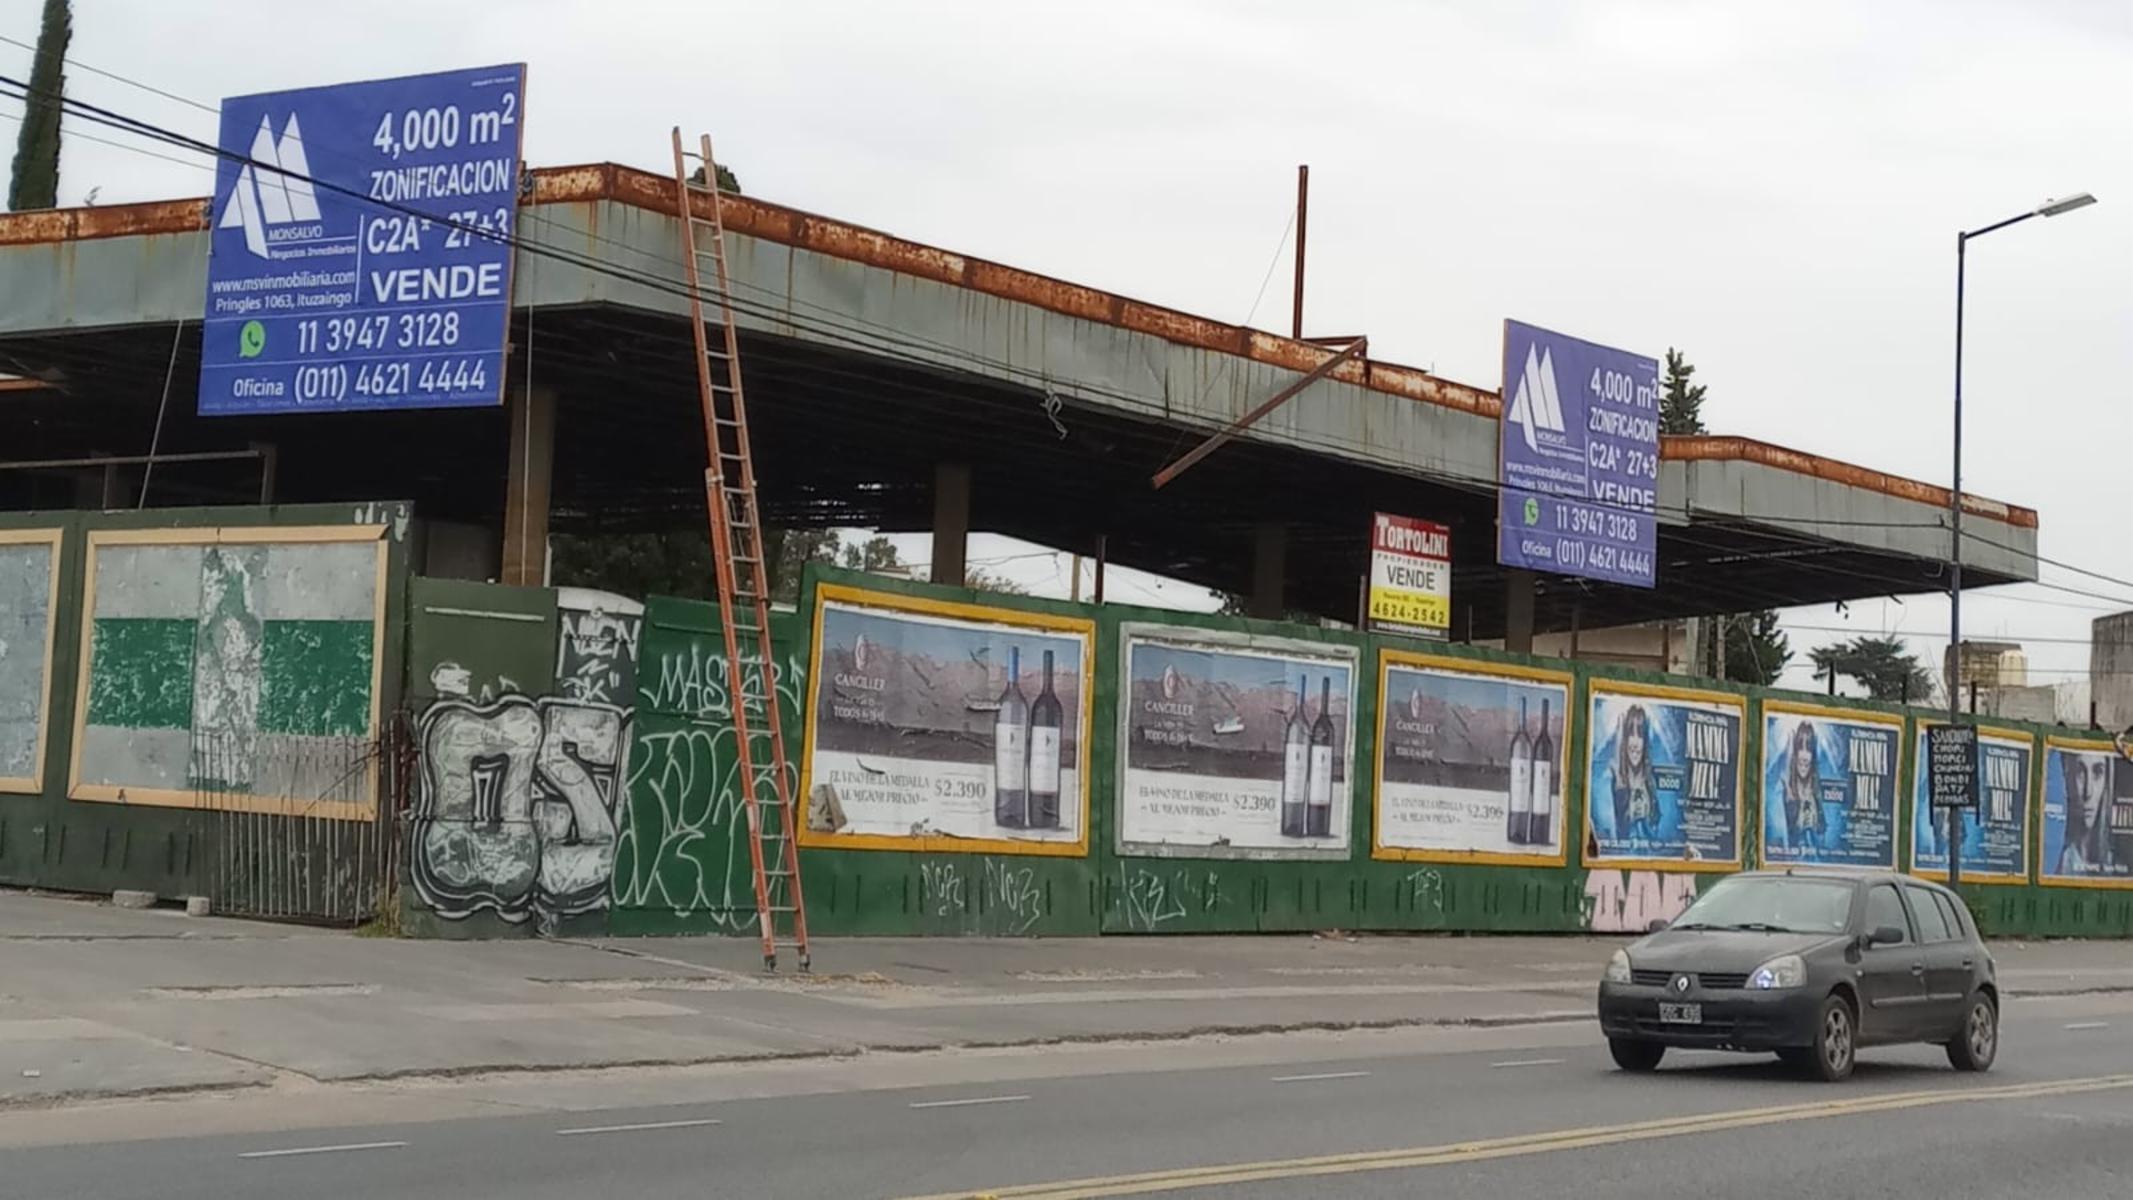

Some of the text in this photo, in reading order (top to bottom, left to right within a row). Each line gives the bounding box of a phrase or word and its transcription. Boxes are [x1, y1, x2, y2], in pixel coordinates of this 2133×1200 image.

[374, 106, 459, 159] 4,000
[370, 159, 511, 201] ZONIFICACION
[268, 225, 322, 240] MONSALVO
[212, 270, 355, 293] www.msvinmobiliaria.com
[371, 263, 502, 303] VENDE
[215, 291, 352, 314] Pringles 1063, Ituzaingo
[298, 311, 460, 353] 11 3947 3128
[233, 378, 284, 397] Oficina
[294, 364, 347, 403] (011)
[355, 362, 410, 395] 4621
[418, 359, 486, 393] 4444
[1590, 367, 1632, 403] 4,000
[1589, 406, 1657, 443] ZONIFICACION
[1627, 450, 1657, 479] 27+3
[1592, 480, 1655, 513] VENDE
[1376, 516, 1448, 557] TORTOLINI
[1556, 504, 1637, 541] 11 3947 3128
[1521, 538, 1650, 576] Oficina (011) 4621 4444
[1387, 564, 1435, 590] VENDE
[934, 779, 987, 799] $2.390
